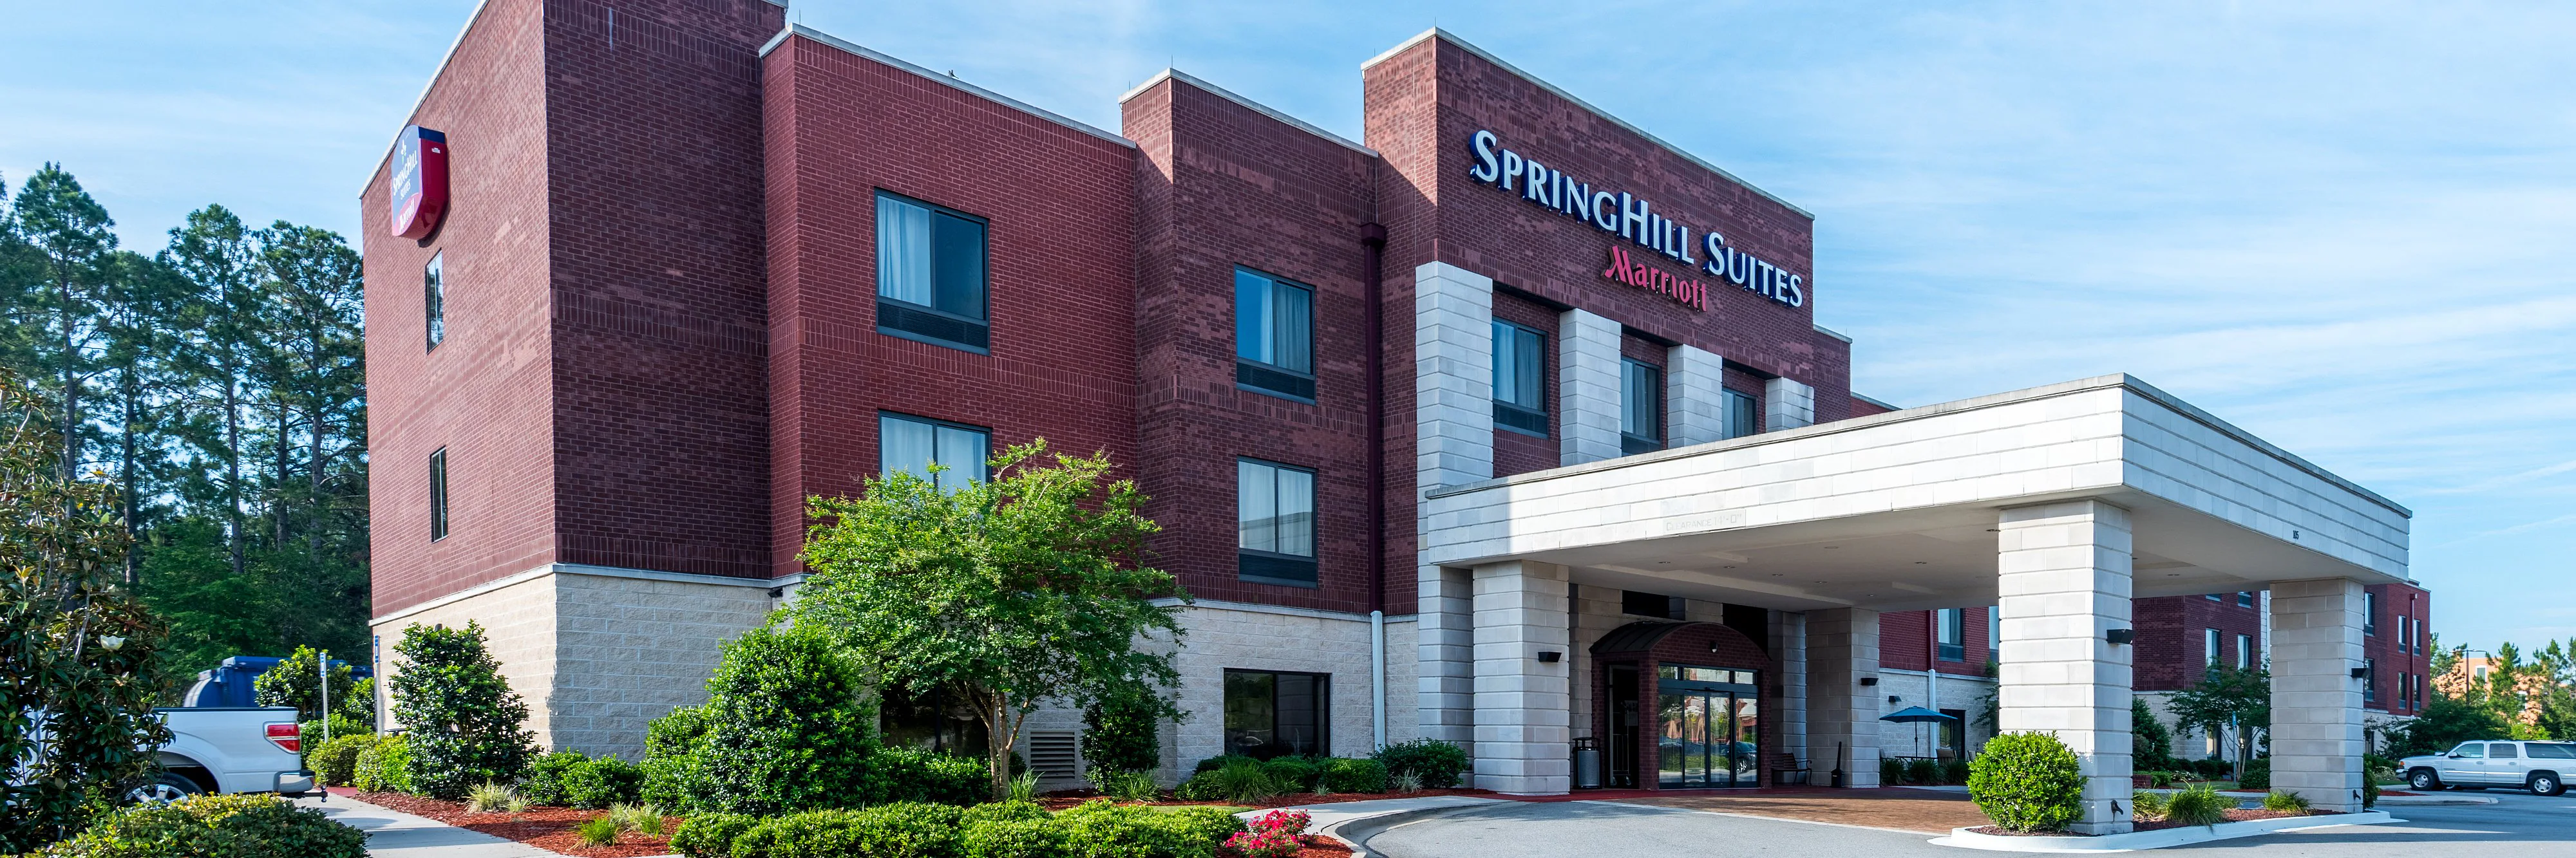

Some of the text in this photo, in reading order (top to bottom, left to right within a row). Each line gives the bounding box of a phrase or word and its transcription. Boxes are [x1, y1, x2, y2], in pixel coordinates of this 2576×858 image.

[393, 151, 417, 196] SPRINGHILL
[1469, 130, 1804, 308] SPRINGHILL SUITES
[1605, 245, 1707, 312] Marriott
[1666, 519, 1712, 531] CLEARANCE
